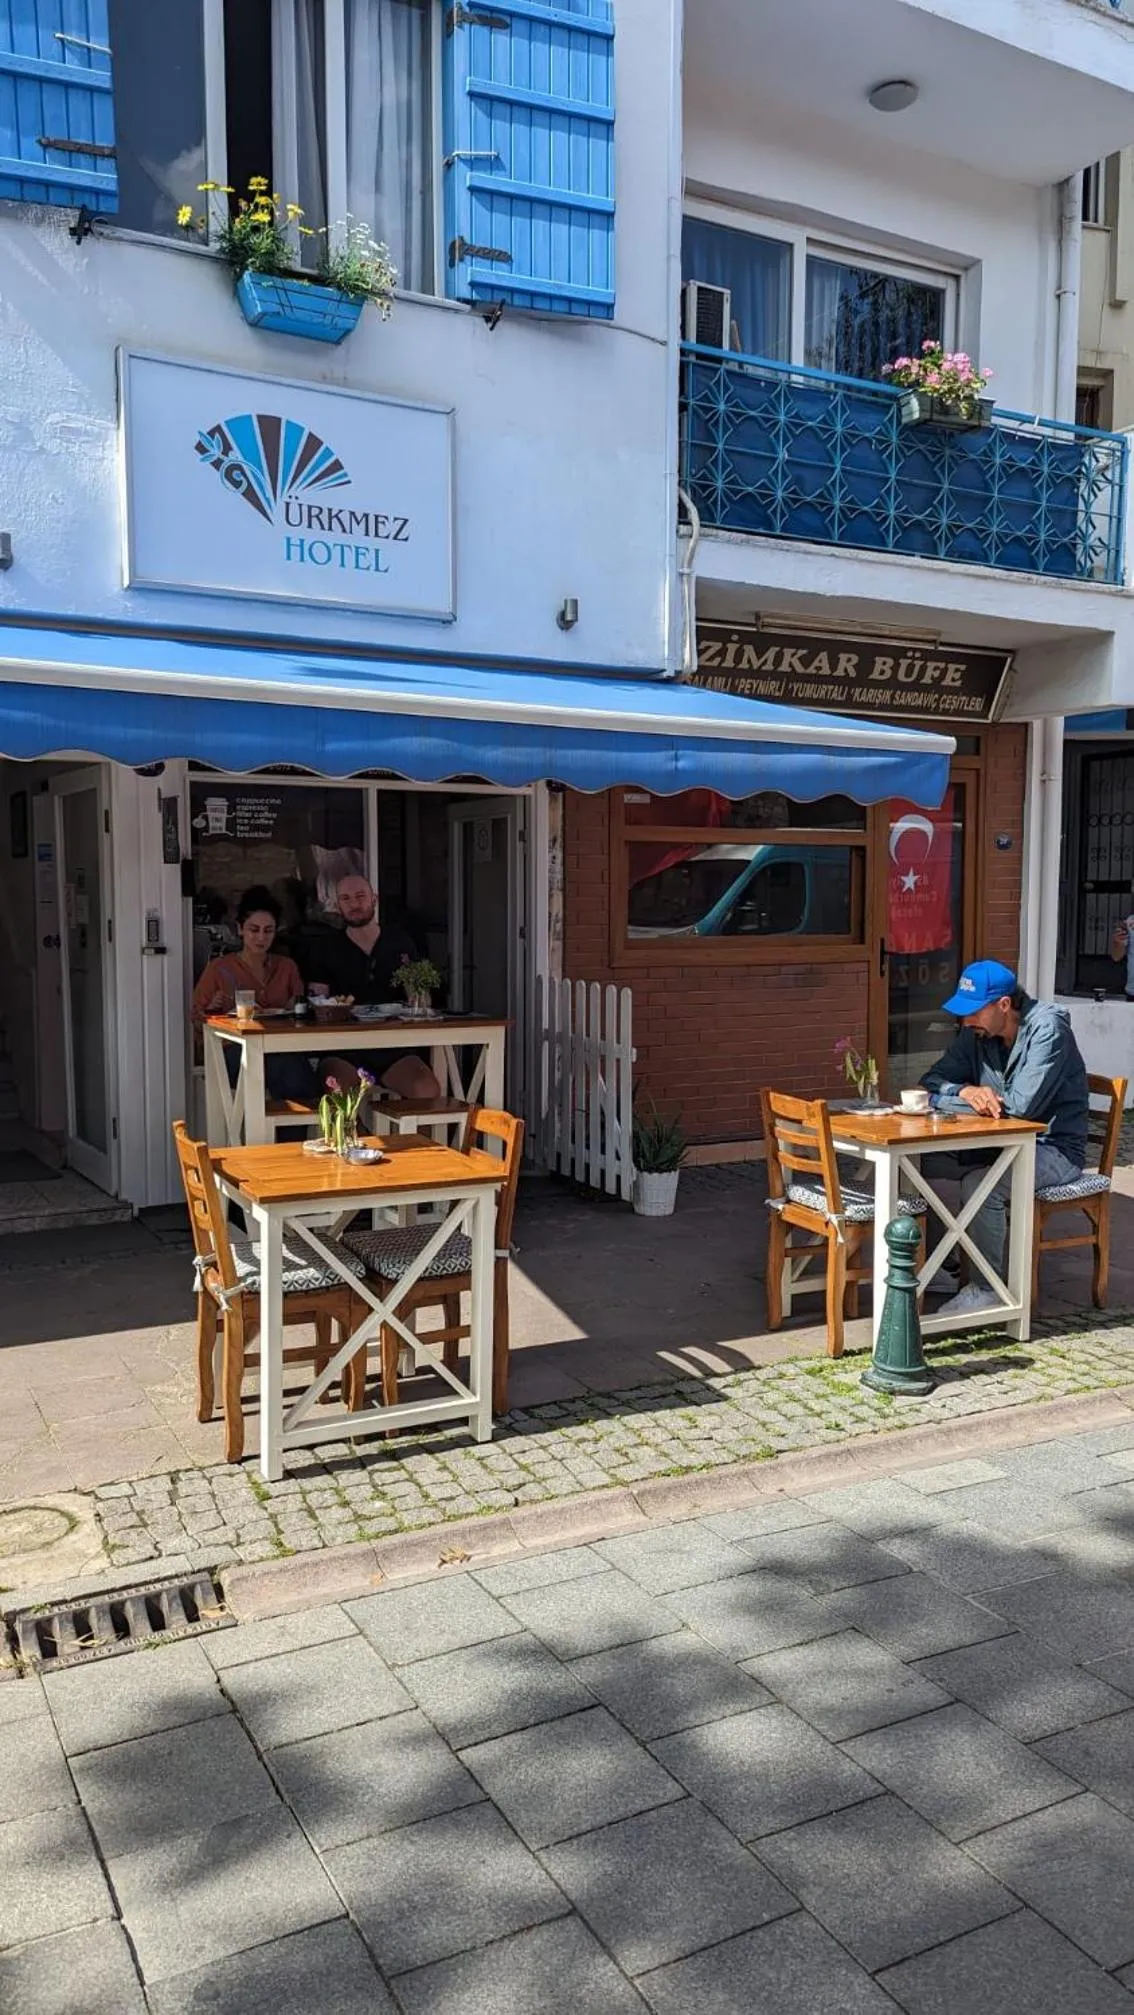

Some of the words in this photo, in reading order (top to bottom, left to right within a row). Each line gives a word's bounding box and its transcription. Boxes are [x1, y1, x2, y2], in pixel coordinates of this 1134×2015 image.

[284, 495, 410, 542] ÜRKMEZ
[284, 537, 390, 573] HOTEL
[699, 634, 859, 677] ZİMKAR
[869, 652, 968, 687] BÜFE
[939, 693, 986, 713] ÇEŞİTLERİ
